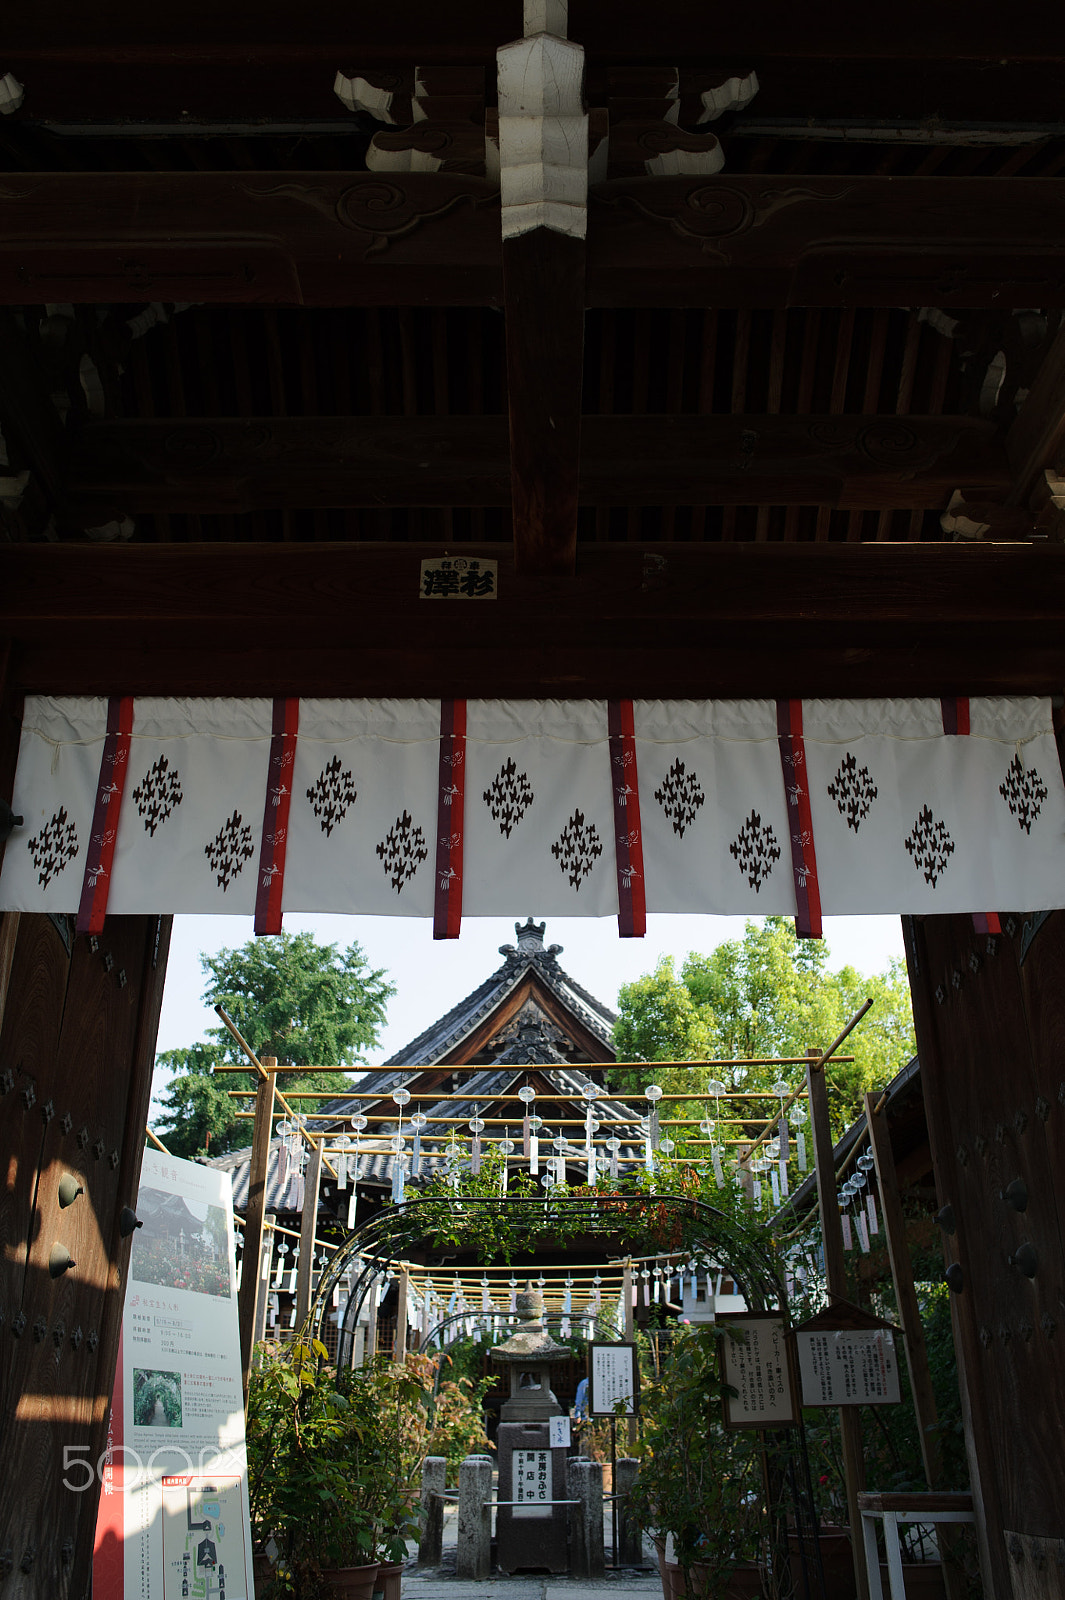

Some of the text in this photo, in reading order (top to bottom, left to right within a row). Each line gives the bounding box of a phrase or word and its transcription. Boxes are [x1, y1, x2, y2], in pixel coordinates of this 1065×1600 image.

[765, 1362, 777, 1408] 付き添いの方へ
[526, 1452, 535, 1500] 開店中
[538, 1452, 547, 1500] 茶房おふさ
